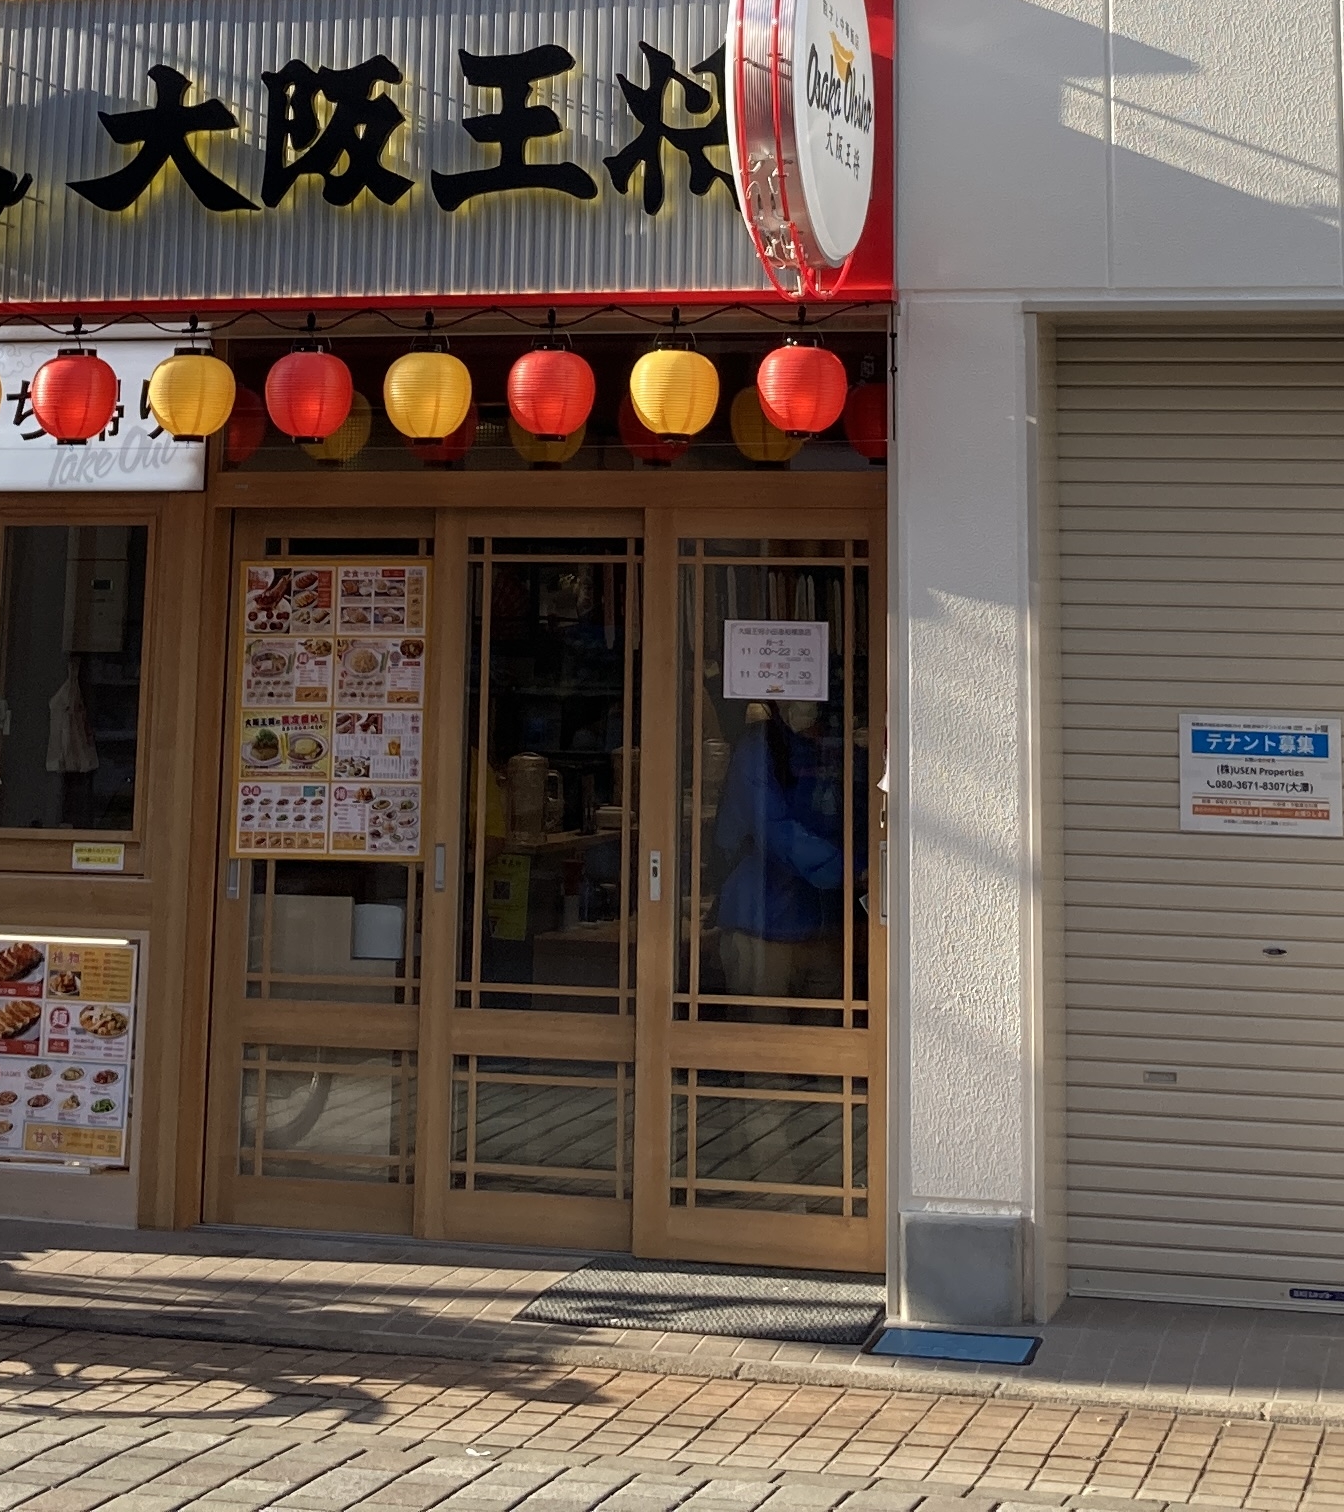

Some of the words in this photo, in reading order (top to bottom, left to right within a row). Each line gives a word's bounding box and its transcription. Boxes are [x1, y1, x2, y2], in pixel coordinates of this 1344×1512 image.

[806, 42, 842, 121] Osaka
[843, 62, 874, 135] Ohsho
[825, 122, 860, 180] 大阪王将
[48, 442, 117, 488] Take
[119, 426, 177, 474] Out
[1206, 733, 1315, 755] テナント募集
[1259, 767, 1304, 778] Properties
